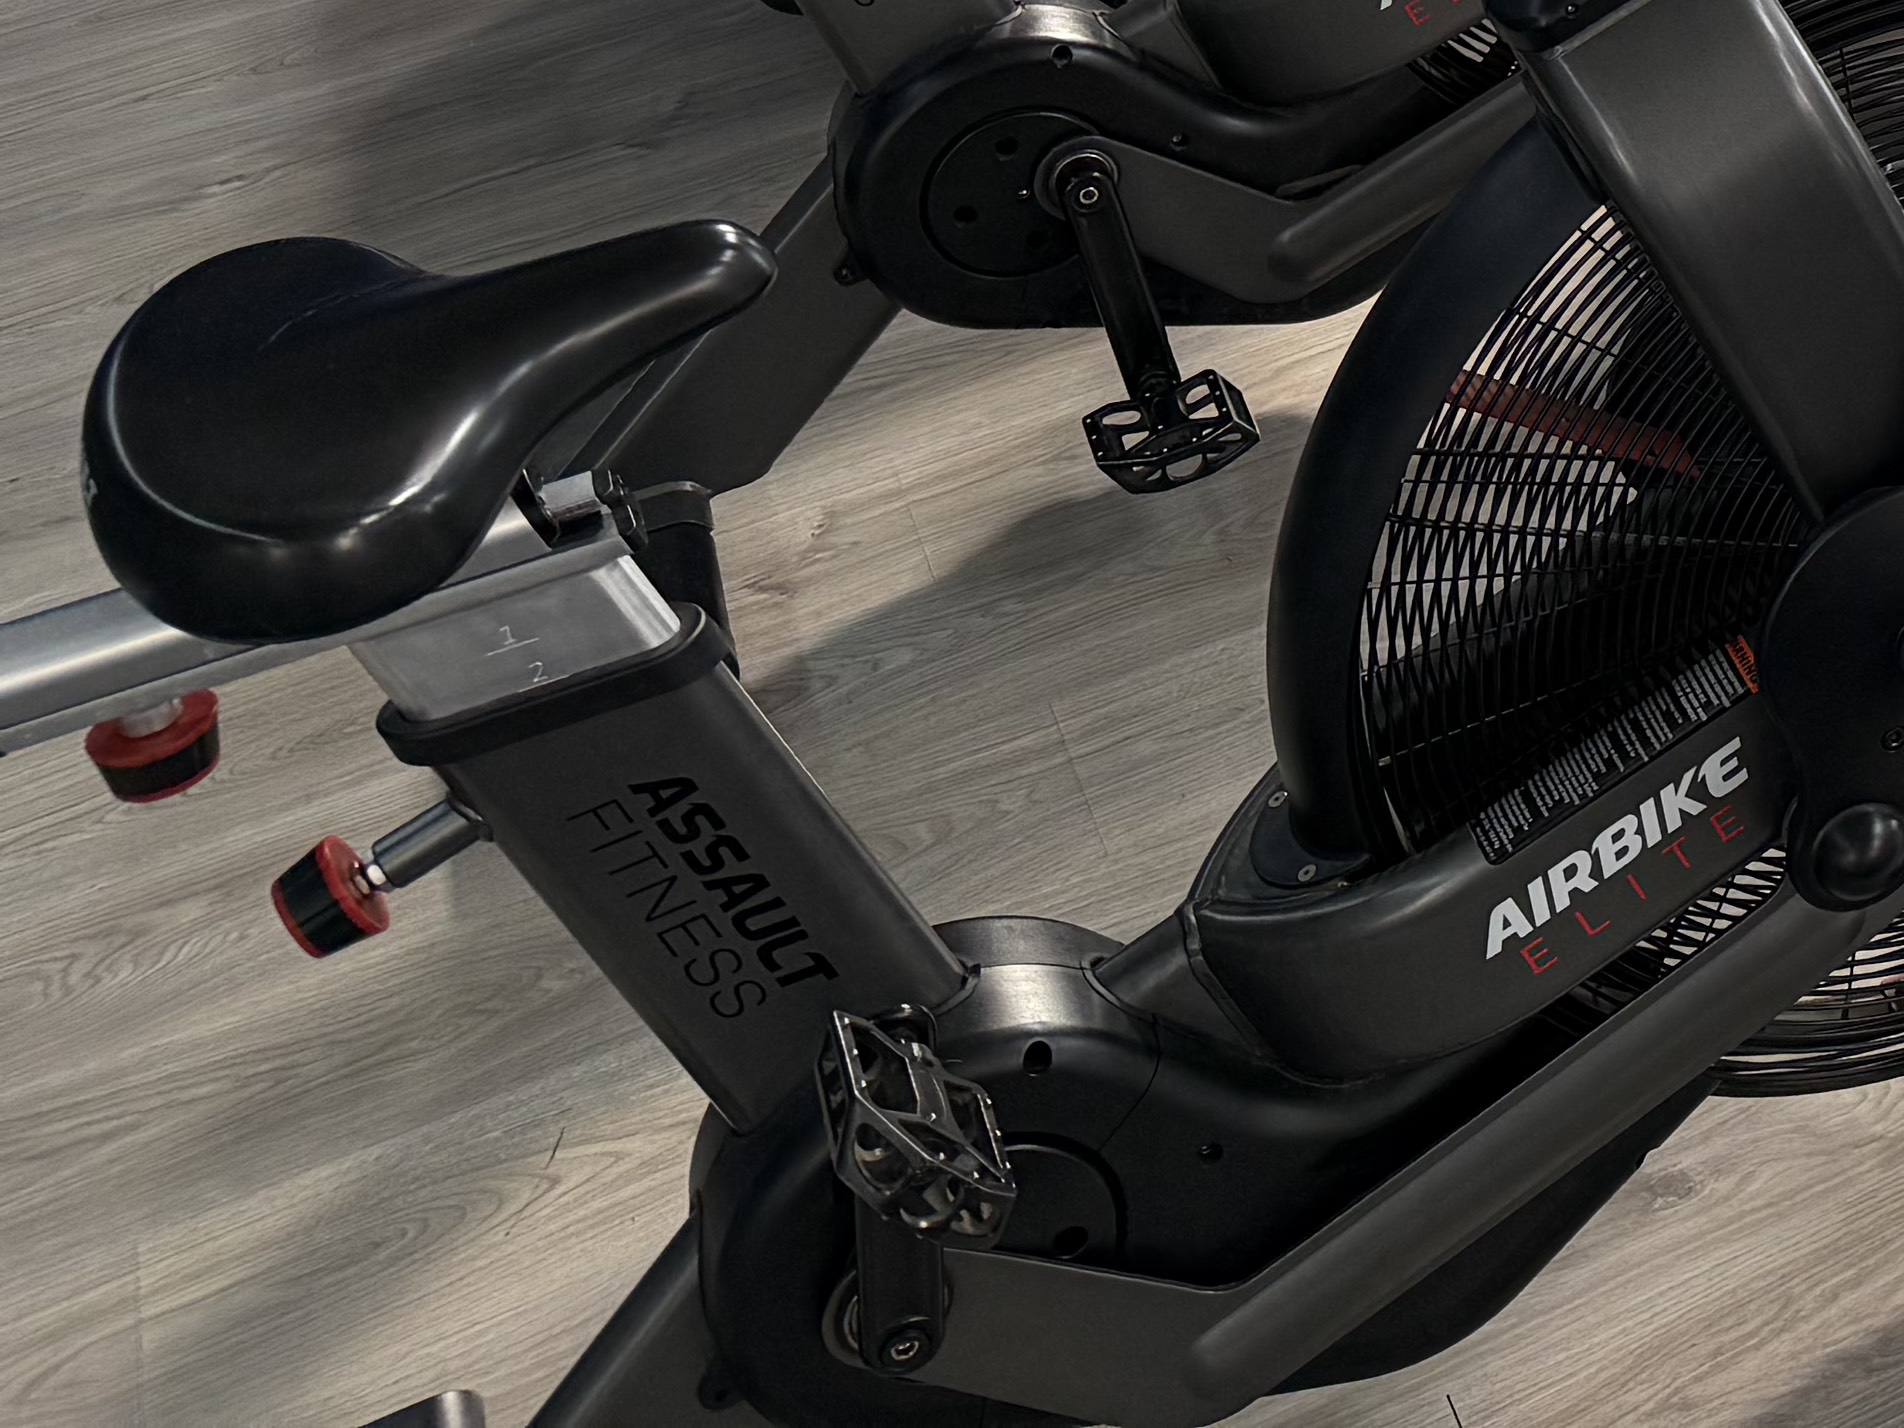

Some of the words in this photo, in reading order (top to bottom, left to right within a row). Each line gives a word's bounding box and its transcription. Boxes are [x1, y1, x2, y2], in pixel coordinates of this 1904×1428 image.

[565, 798, 767, 1020] FITNESS
[627, 775, 840, 989] ASSAULT
[1486, 736, 1749, 960] AIRBIKE
[1519, 805, 1745, 975] ELITE
